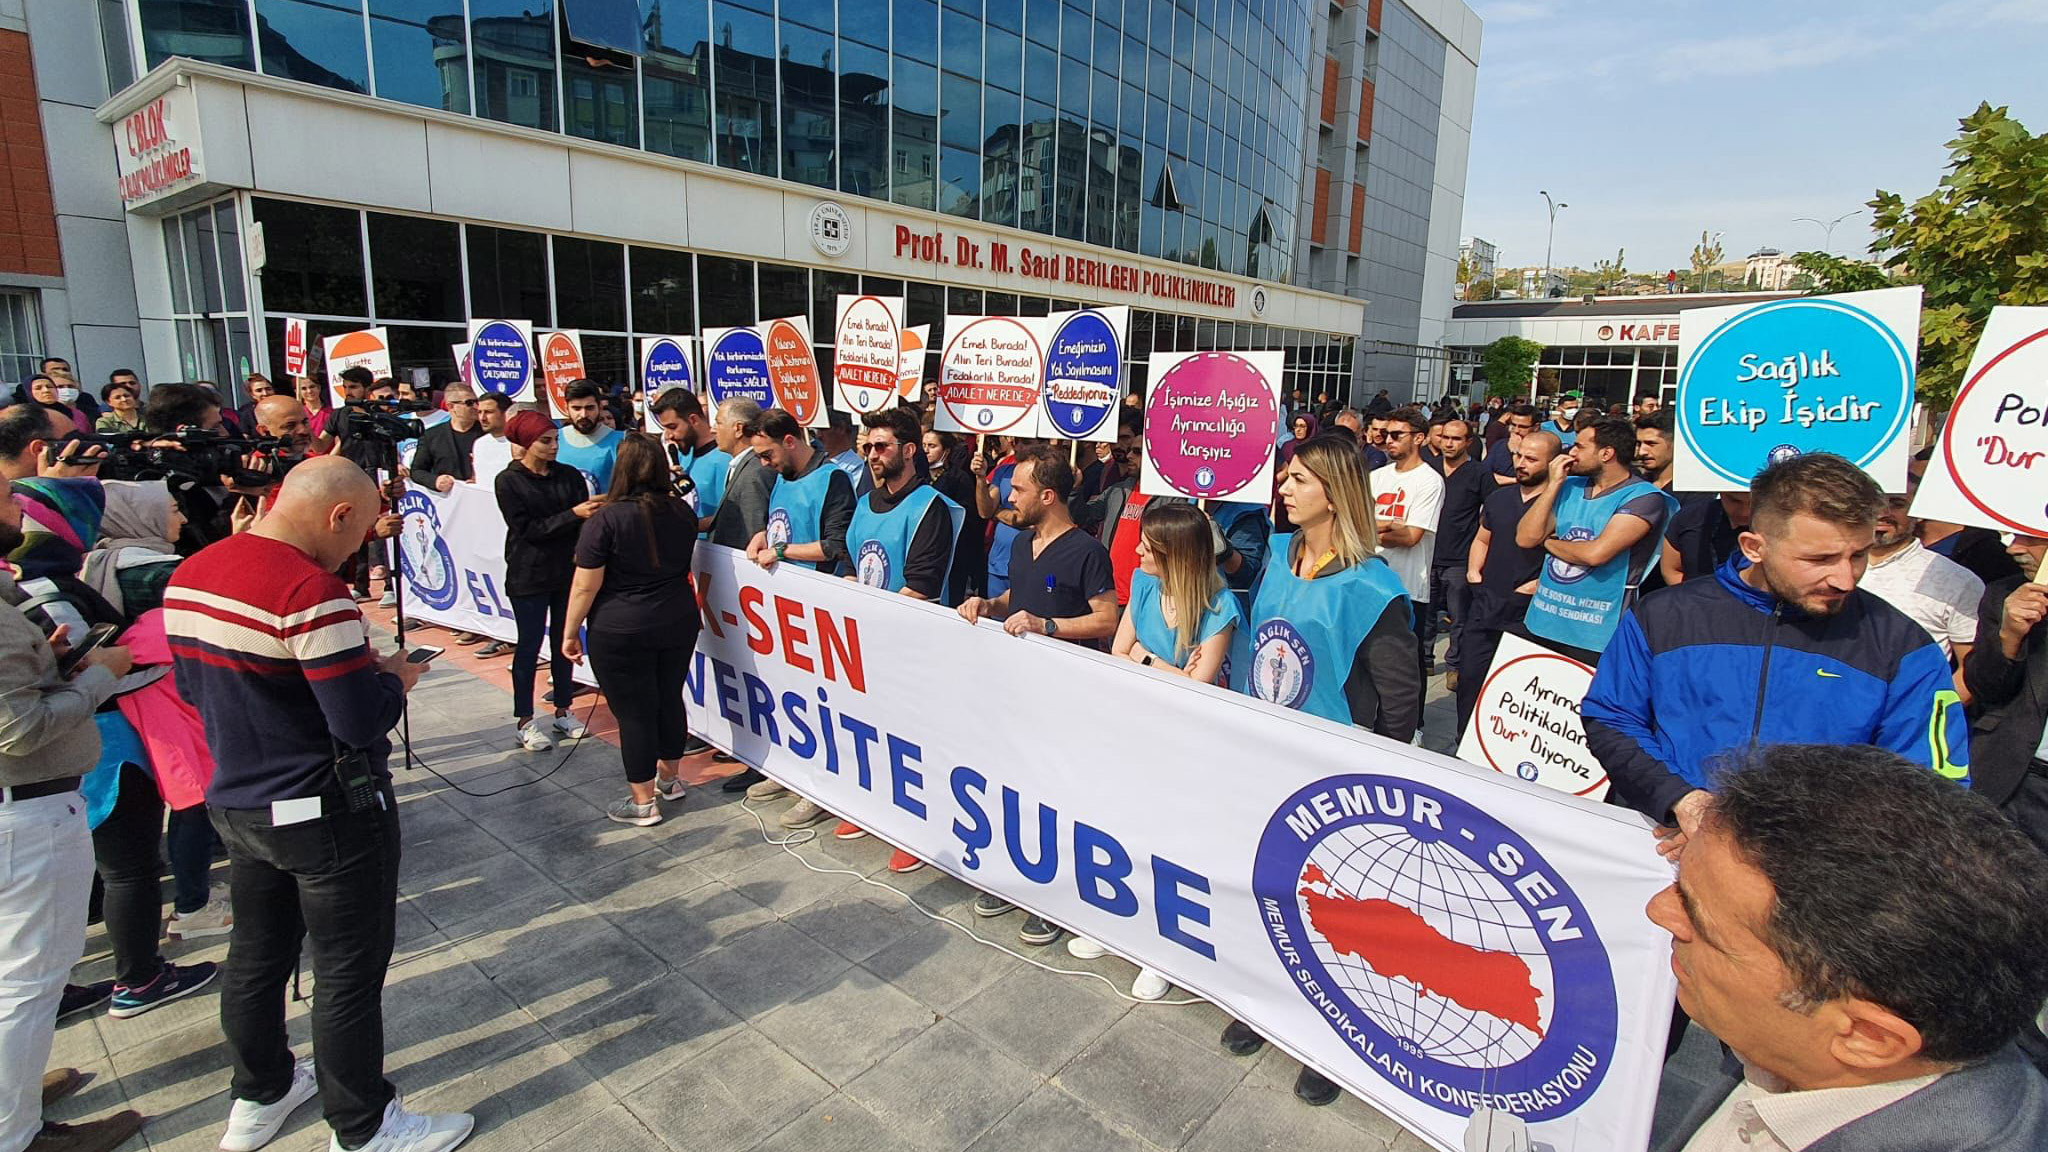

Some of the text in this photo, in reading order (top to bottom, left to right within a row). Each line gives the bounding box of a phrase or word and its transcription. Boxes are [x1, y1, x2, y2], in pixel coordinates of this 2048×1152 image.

[133, 98, 168, 153] BLOK
[895, 224, 949, 264] Prof.
[956, 235, 983, 269] Dr.
[991, 242, 1014, 273] M.
[1020, 247, 1060, 281] Said
[1065, 255, 1139, 293] BERİLGEN
[847, 317, 889, 332] Emek Burada!
[868, 336, 893, 350] Burada!
[961, 337, 1028, 351] Emek Burada!
[1058, 338, 1107, 358] Emeğimizin
[870, 353, 895, 367] Burada!
[953, 353, 1033, 368] Alın Teri Burada!
[1051, 362, 1112, 377] Yok Sayılmasını
[1736, 349, 1841, 388] Sağlık
[997, 371, 1035, 384] Burada!
[944, 386, 983, 400] ADALET
[1163, 385, 1259, 413] İşimize Aşığız
[1699, 388, 1882, 432] Ekip İşidir
[1170, 413, 1246, 438] Ayrımcılığa
[1179, 438, 1232, 462] Karşıyız
[1578, 596, 1613, 612] HİZMET
[1290, 638, 1311, 667] SEN
[1489, 714, 1590, 780] "Dur" Diyoruz
[948, 765, 1217, 961] ŞUBE
[1284, 784, 1443, 843] MEMUR
[1487, 842, 1584, 943] SEN
[1262, 896, 1599, 1115] MEMUR SENDİKALARI KONFEDERASYONU
[1396, 1036, 1426, 1060] 1995
